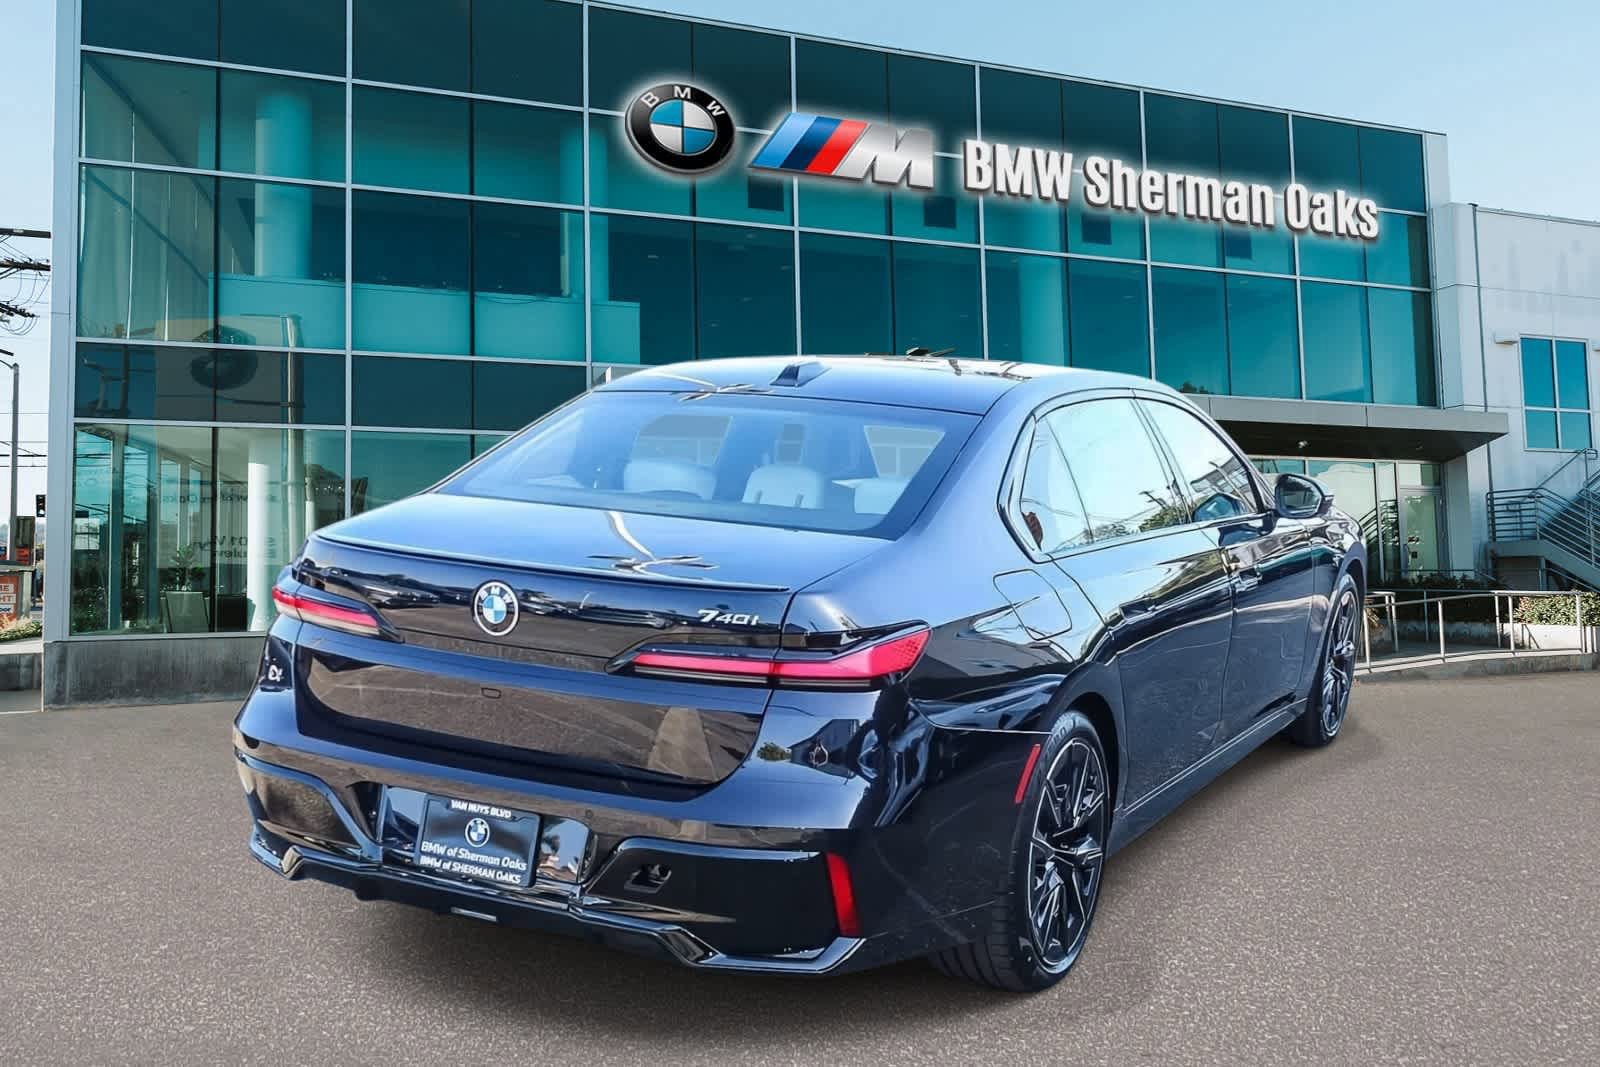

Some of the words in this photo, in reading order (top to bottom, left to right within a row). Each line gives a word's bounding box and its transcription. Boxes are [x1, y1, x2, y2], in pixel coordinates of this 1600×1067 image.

[963, 139, 1073, 201] BMW
[1083, 155, 1275, 229] Sherman
[1284, 183, 1380, 239] Oaks
[697, 609, 760, 626] 740i
[451, 800, 468, 810] VAN
[468, 803, 490, 815] NUYS
[491, 807, 512, 818] BLVD
[420, 856, 441, 868] BMW
[442, 861, 452, 870] of
[452, 862, 495, 878] SHERMAN
[496, 871, 521, 884] OAKS
[421, 841, 446, 855] BMW
[447, 847, 458, 857] of
[458, 848, 500, 865] Sherman
[502, 857, 527, 871] Oaks
